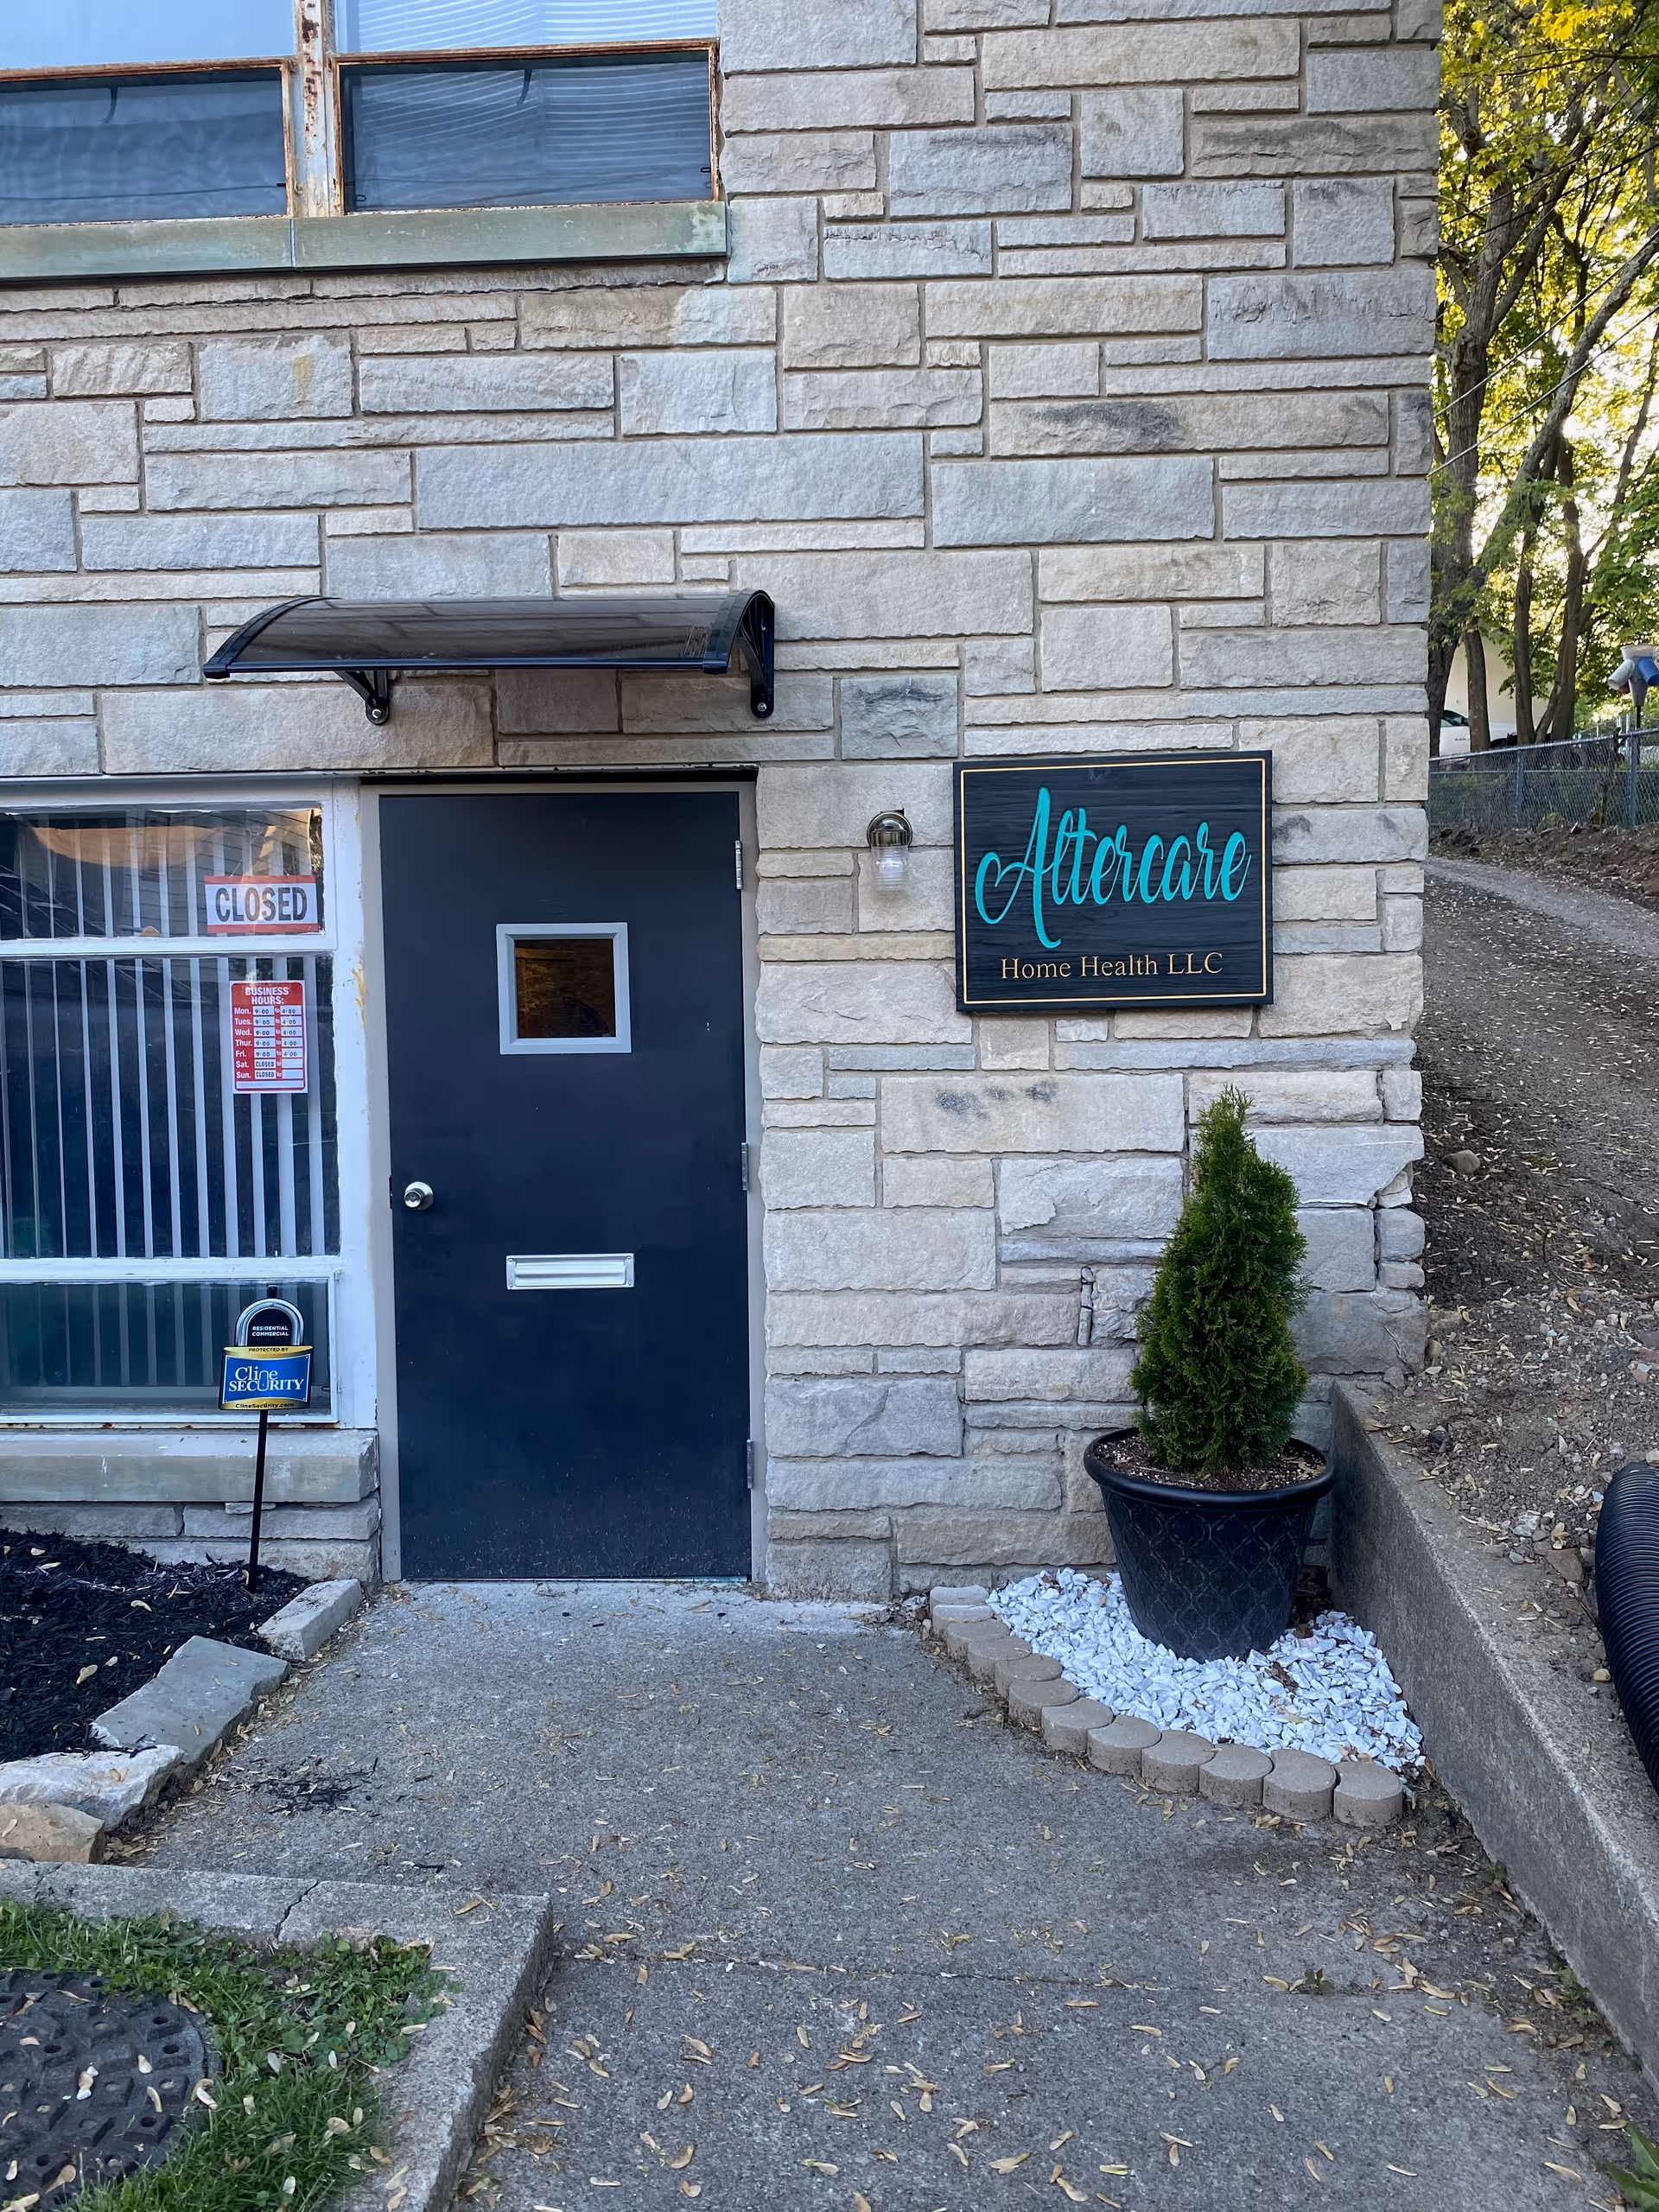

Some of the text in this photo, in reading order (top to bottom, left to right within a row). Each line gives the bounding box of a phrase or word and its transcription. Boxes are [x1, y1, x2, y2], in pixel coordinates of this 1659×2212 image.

[975, 786, 1252, 949] Altercare
[215, 887, 308, 922] CLOSED
[1001, 951, 1224, 979] Home Health LLC
[245, 987, 289, 995] BUSINESS
[251, 996, 284, 1005] HOURS:
[228, 1378, 304, 1392] SECURITY
